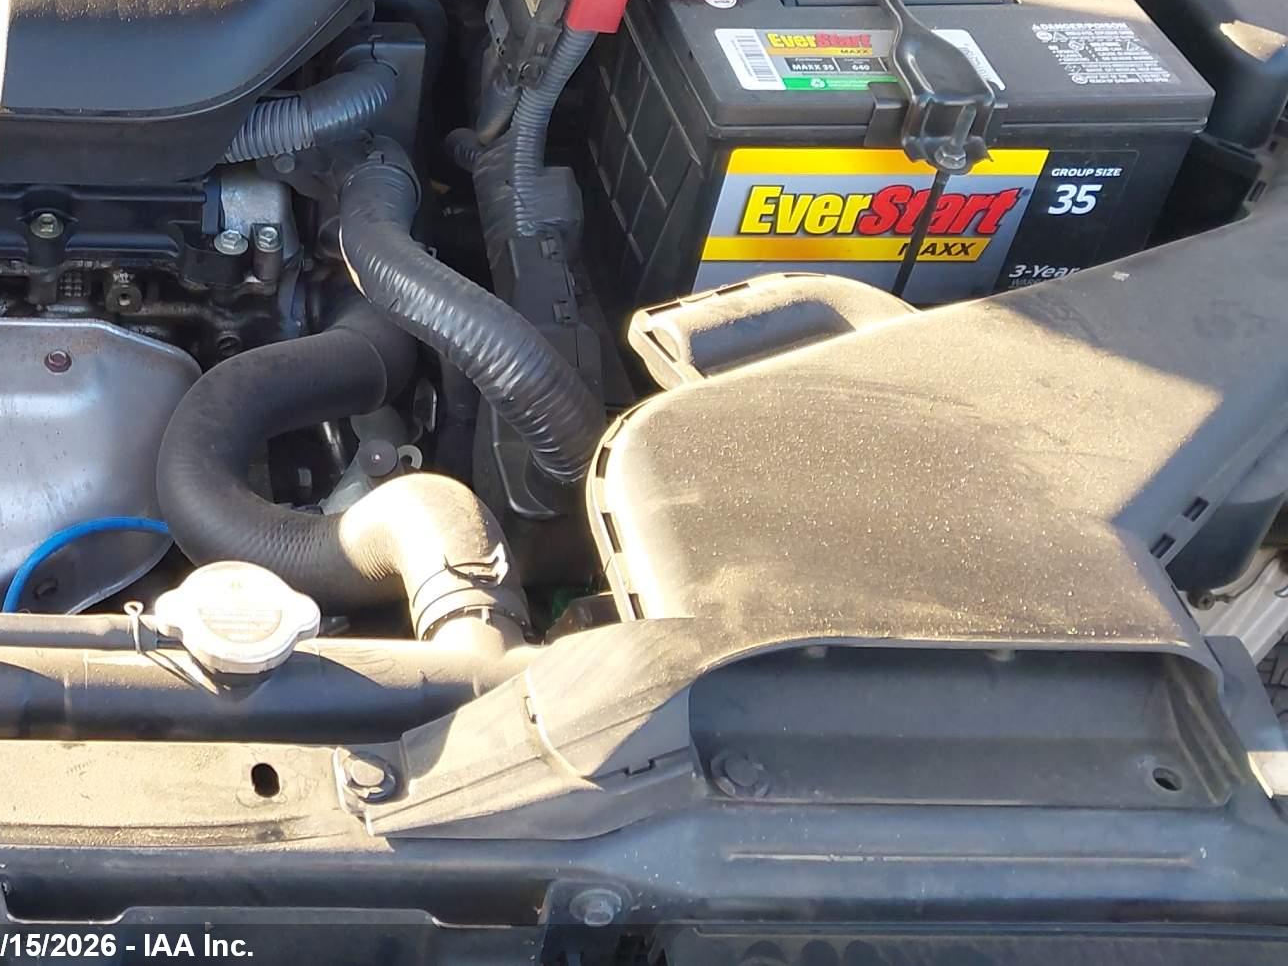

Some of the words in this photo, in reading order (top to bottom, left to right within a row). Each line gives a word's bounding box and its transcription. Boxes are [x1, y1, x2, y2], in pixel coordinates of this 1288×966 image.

[767, 33, 872, 48] EverStart
[1051, 168, 1093, 177] GROUP
[1094, 168, 1123, 177] SIZE
[1047, 184, 1102, 215] 35
[739, 184, 1023, 236] EverStart
[1008, 264, 1081, 279] 3-Year
